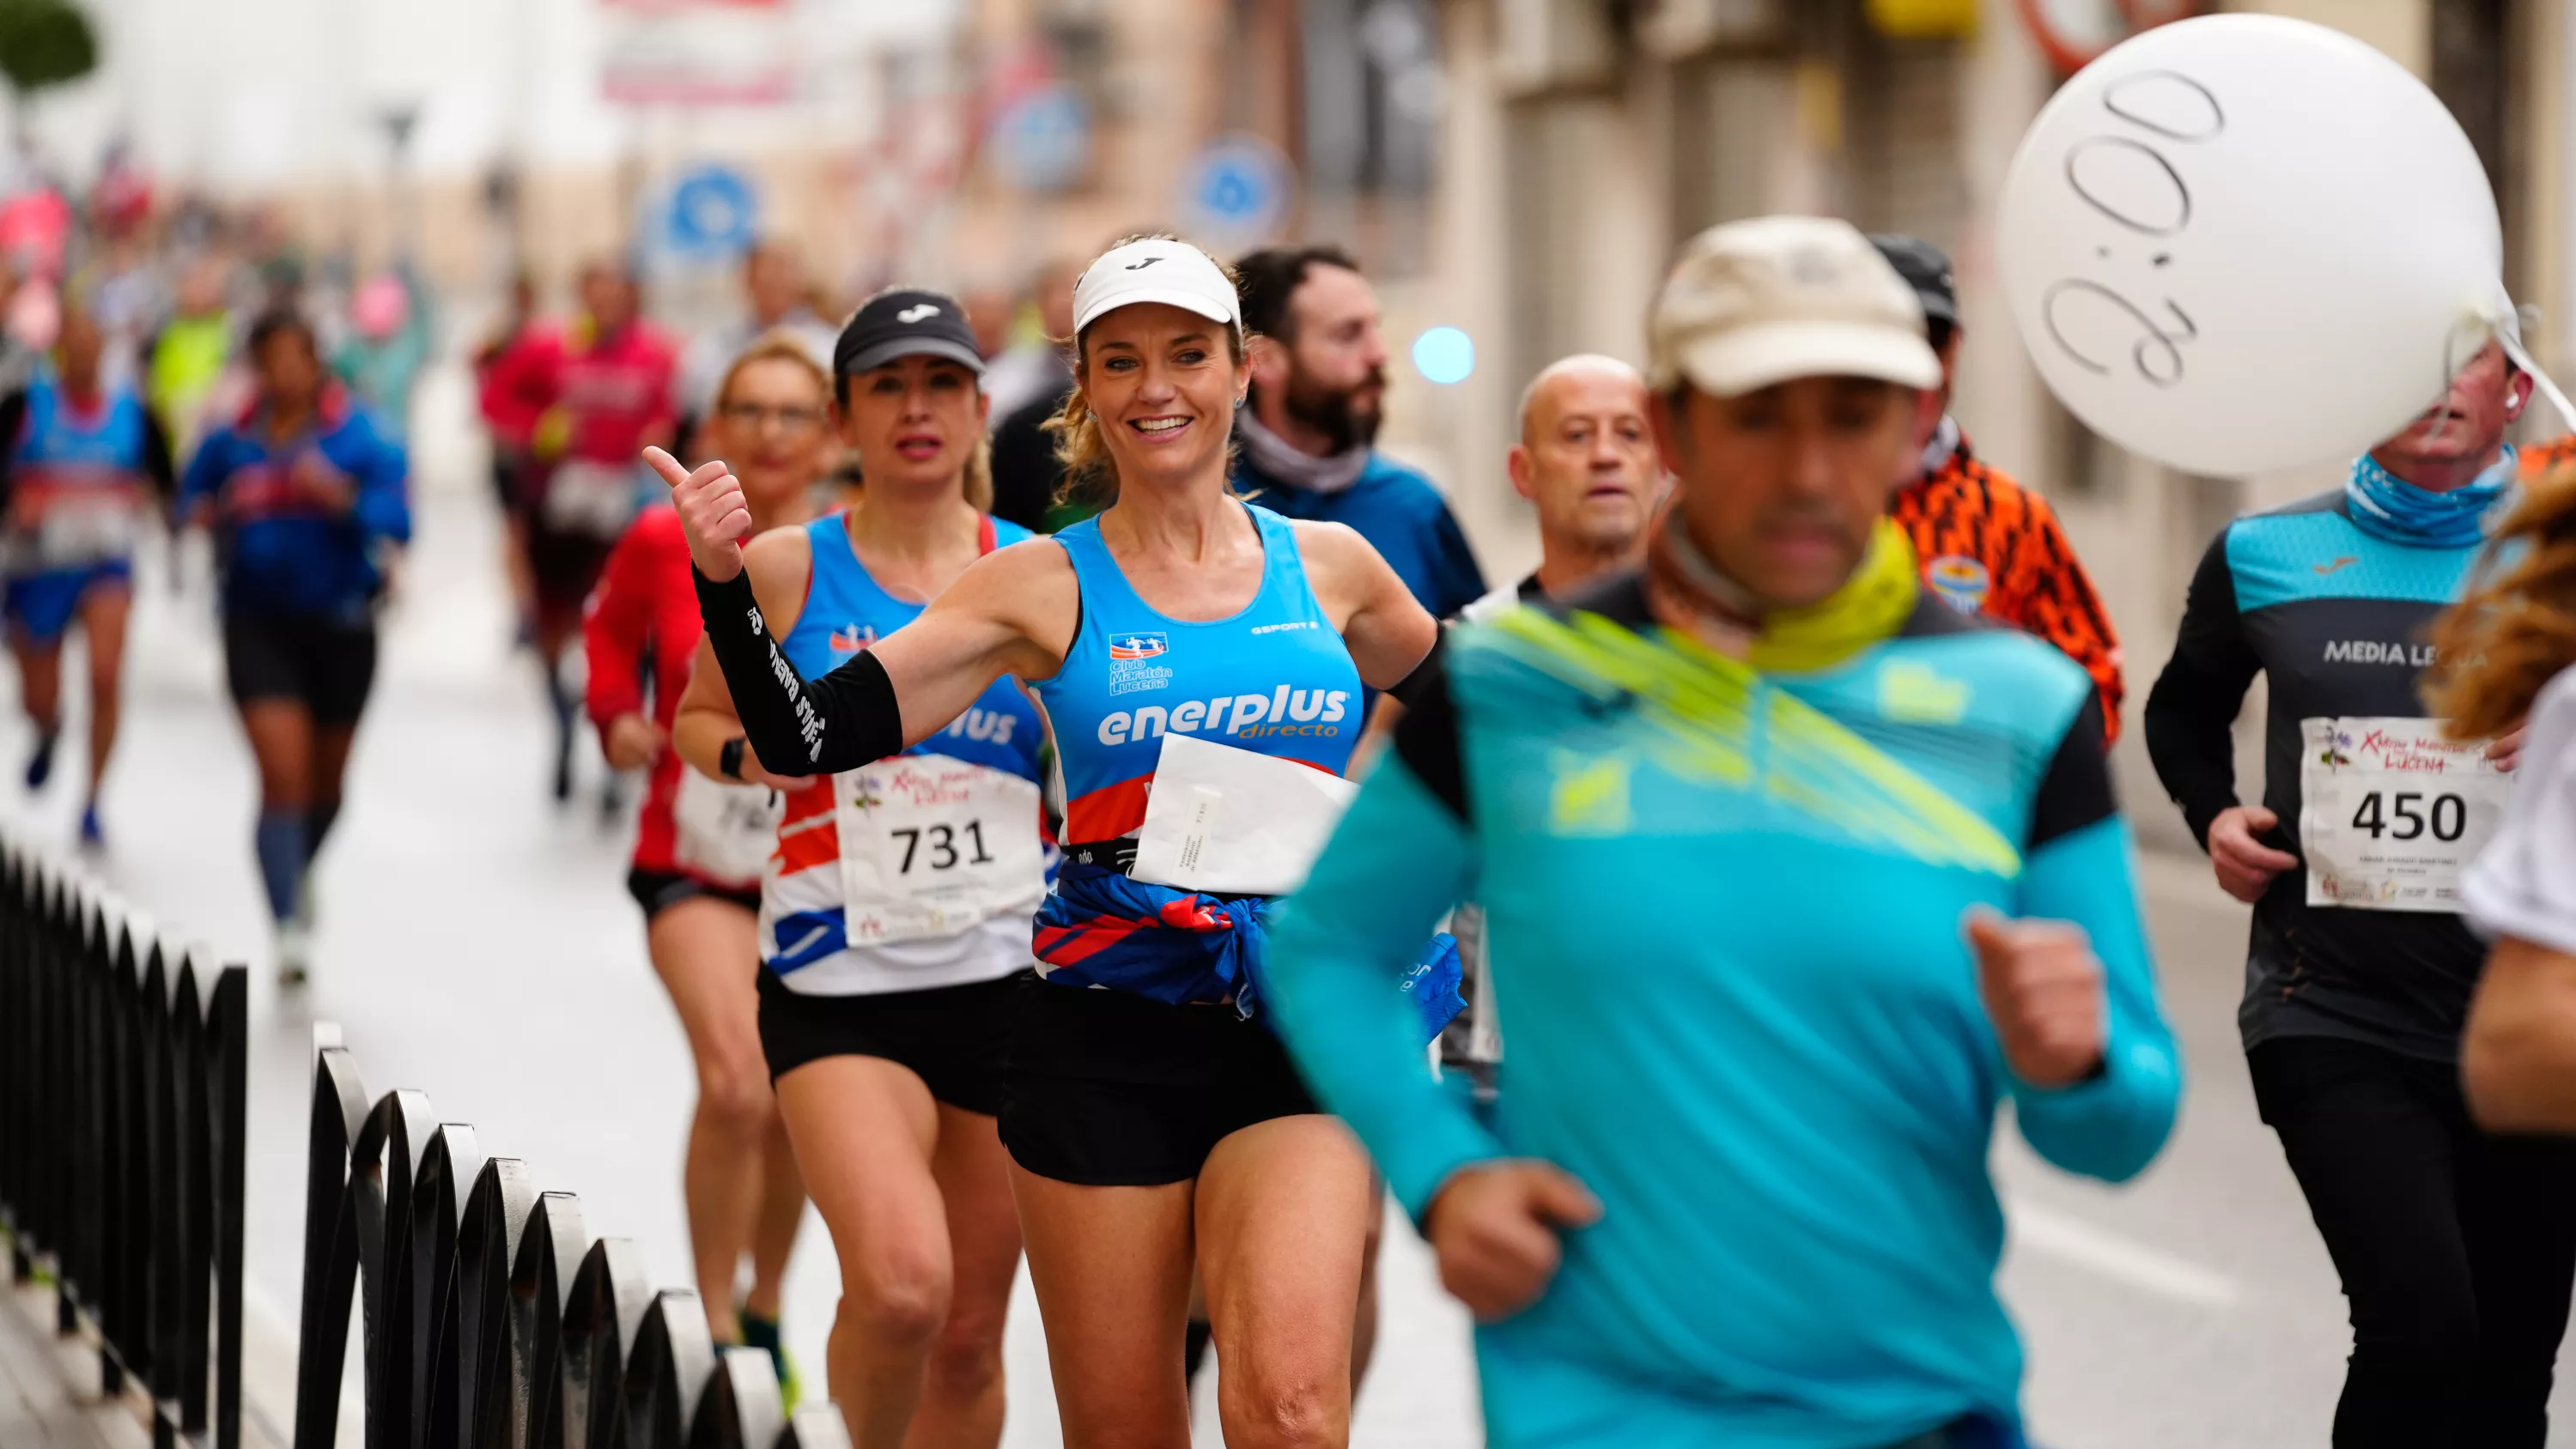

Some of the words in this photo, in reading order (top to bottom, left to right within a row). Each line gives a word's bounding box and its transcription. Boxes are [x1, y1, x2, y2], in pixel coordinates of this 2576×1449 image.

[2043, 69, 2226, 387] 2:00
[2324, 640, 2407, 664] MEDIA
[1109, 658, 1146, 672] Club
[1109, 666, 1174, 683] Maratón
[1109, 678, 1169, 697] Lucena
[1097, 683, 1347, 747] enerplus
[1239, 722, 1340, 740] directo
[2385, 754, 2445, 774] LUCENA
[2352, 791, 2467, 842] 450
[890, 818, 994, 875] 731
